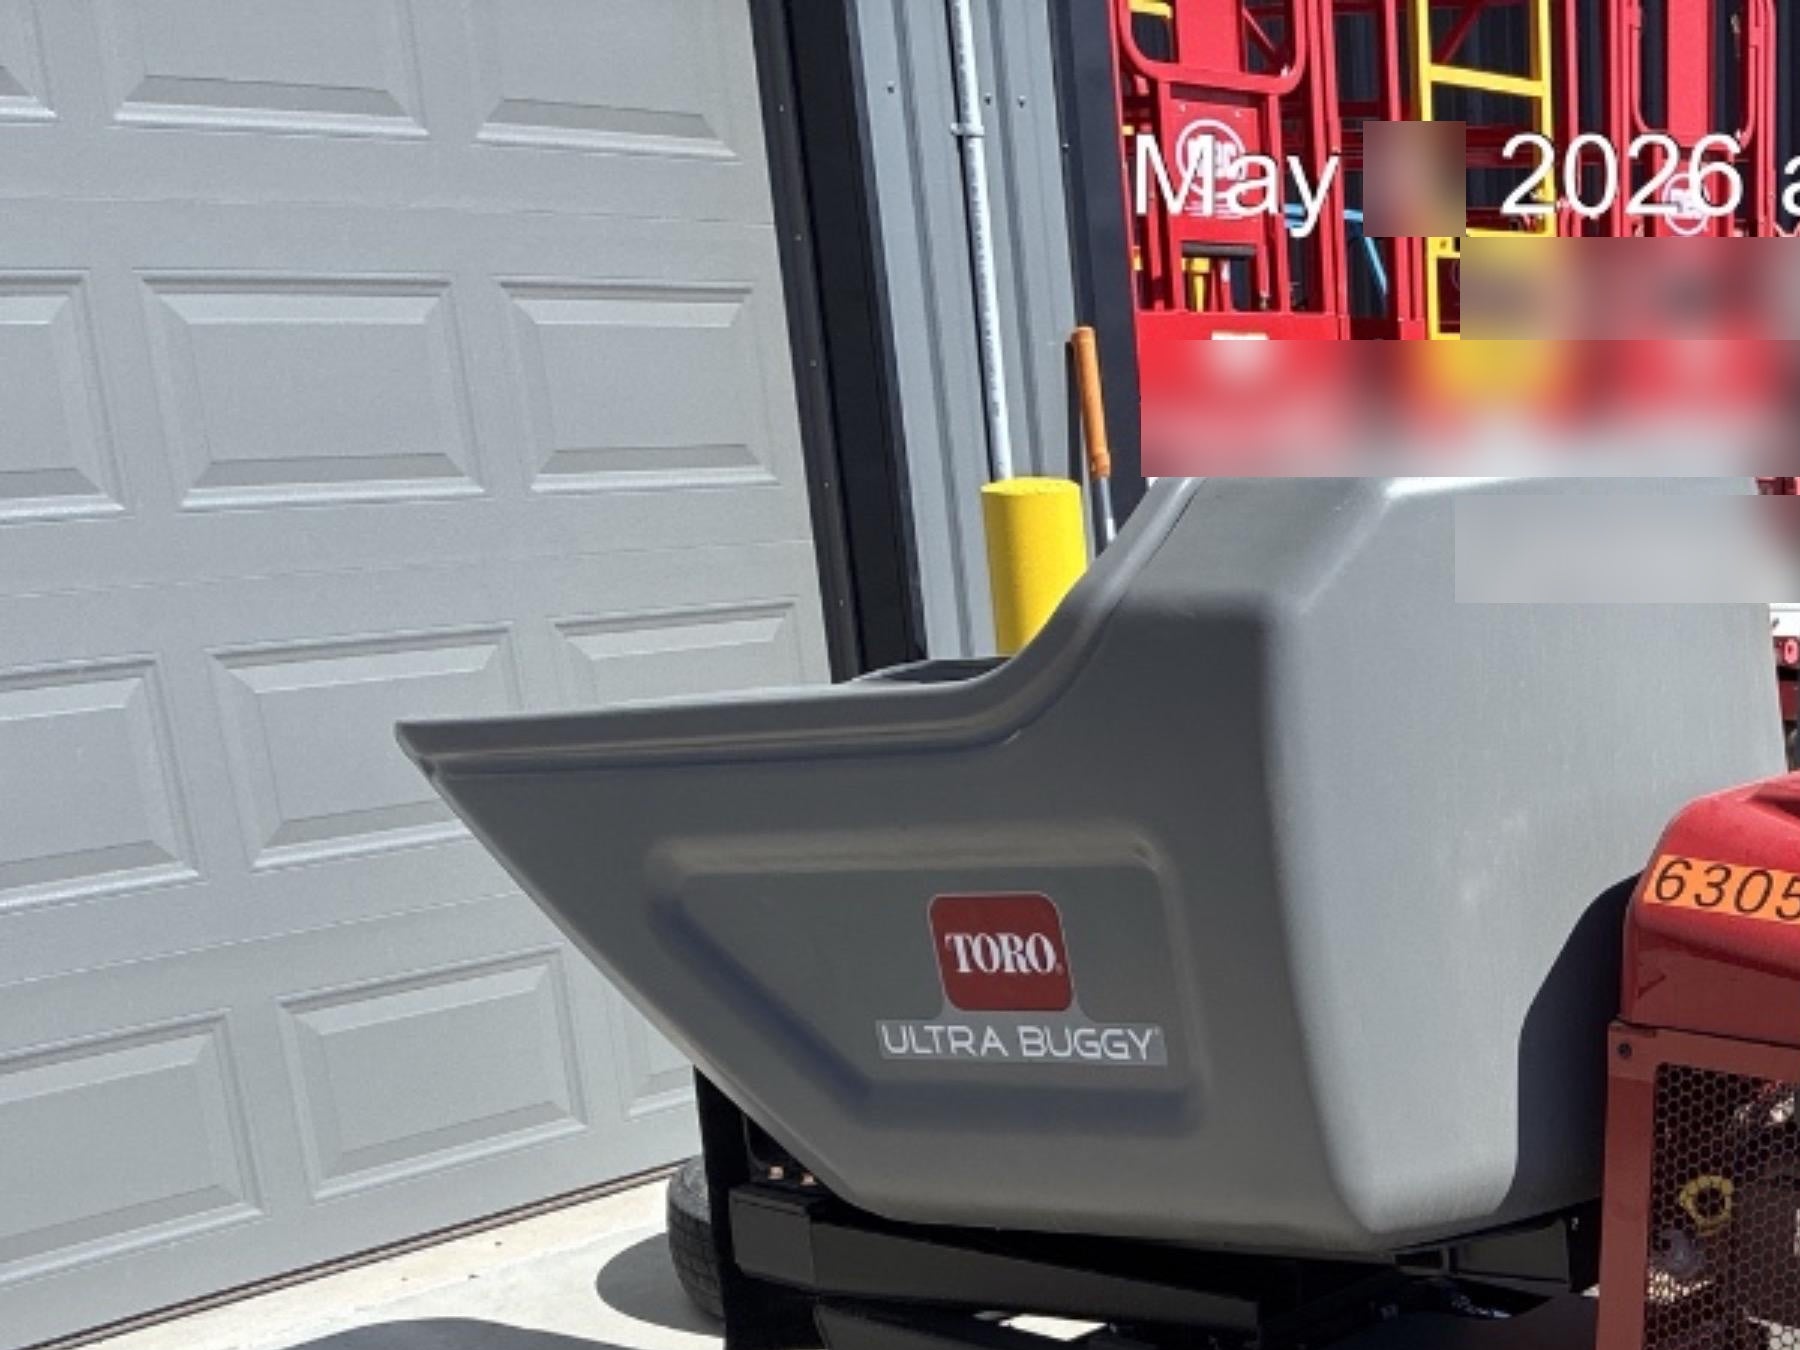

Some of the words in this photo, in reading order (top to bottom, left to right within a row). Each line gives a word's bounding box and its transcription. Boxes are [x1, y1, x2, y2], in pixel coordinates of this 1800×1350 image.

[944, 931, 1058, 975] TORO
[881, 1024, 1009, 1058] ULTRA
[1016, 1025, 1153, 1061] BUGGY
